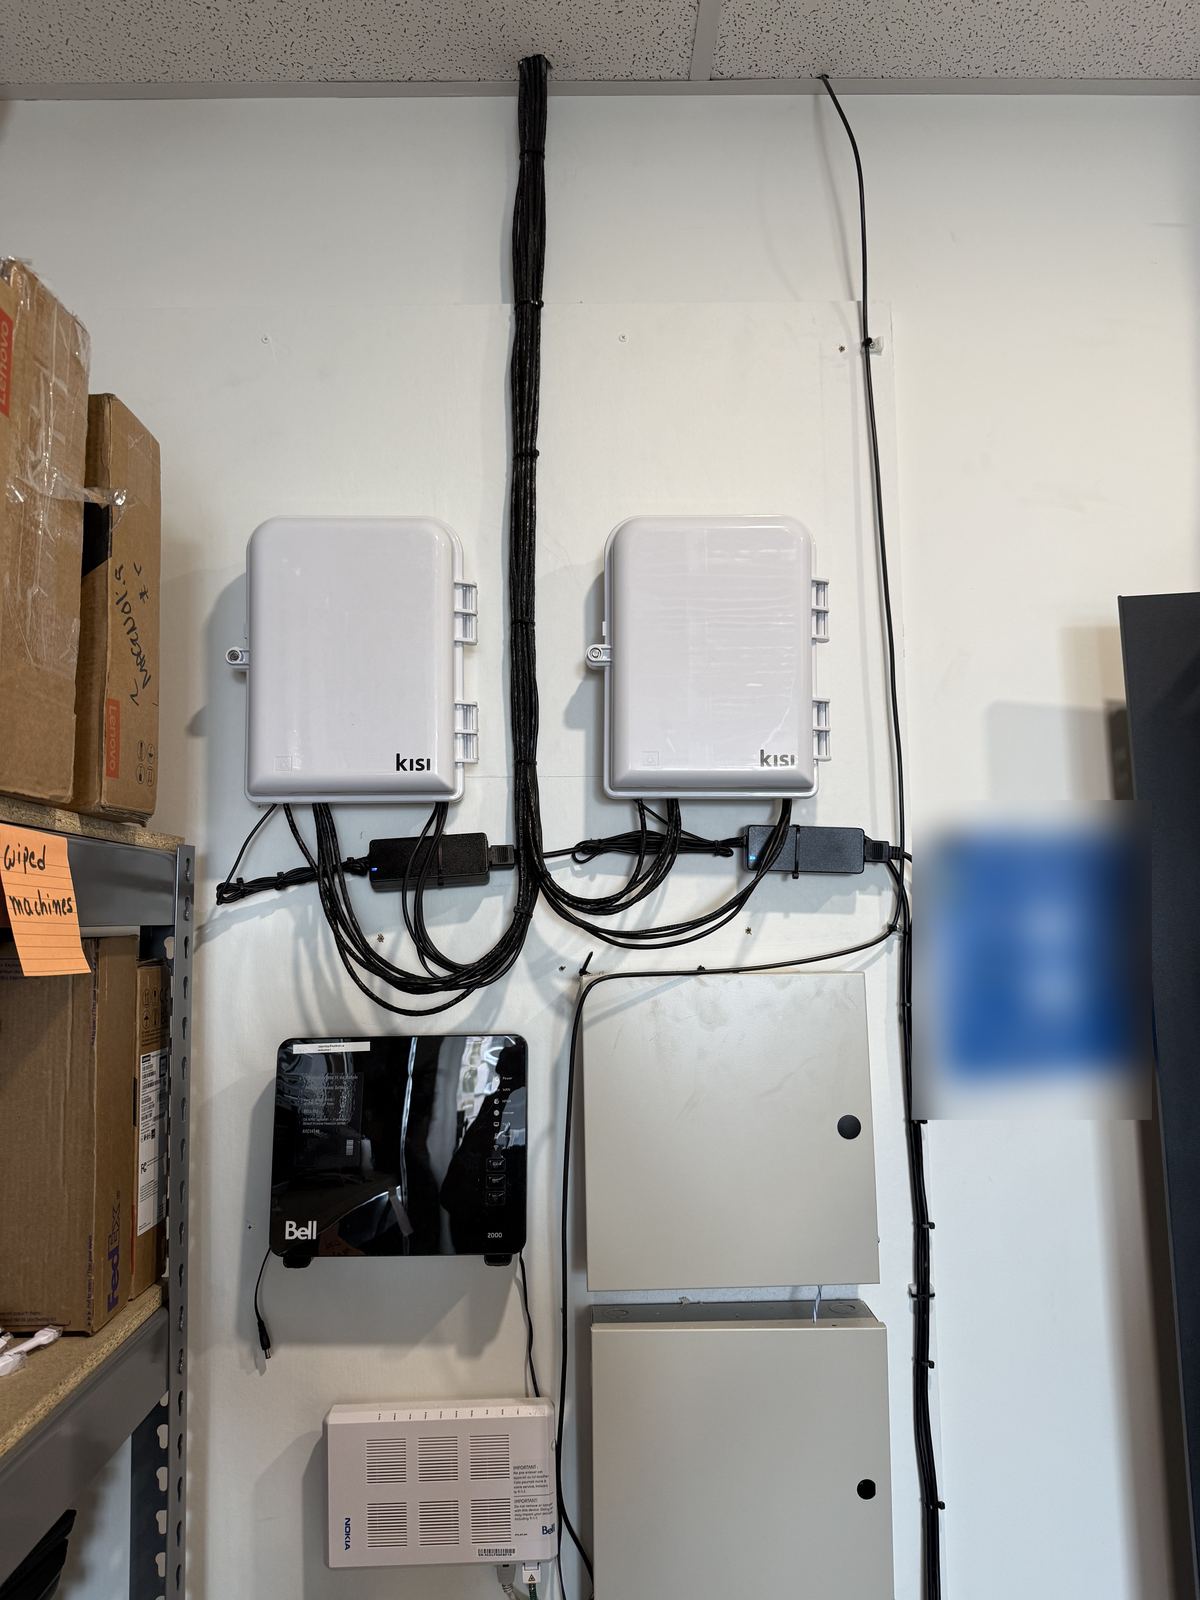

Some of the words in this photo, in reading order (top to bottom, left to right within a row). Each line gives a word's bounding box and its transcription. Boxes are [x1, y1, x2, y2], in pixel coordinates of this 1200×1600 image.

[109, 705, 117, 769] Lenovo
[396, 753, 431, 772] kisi
[760, 749, 795, 767] kisi
[9, 889, 73, 916] machines
[285, 1220, 317, 1240] Bell
[107, 1202, 120, 1313] FedEx
